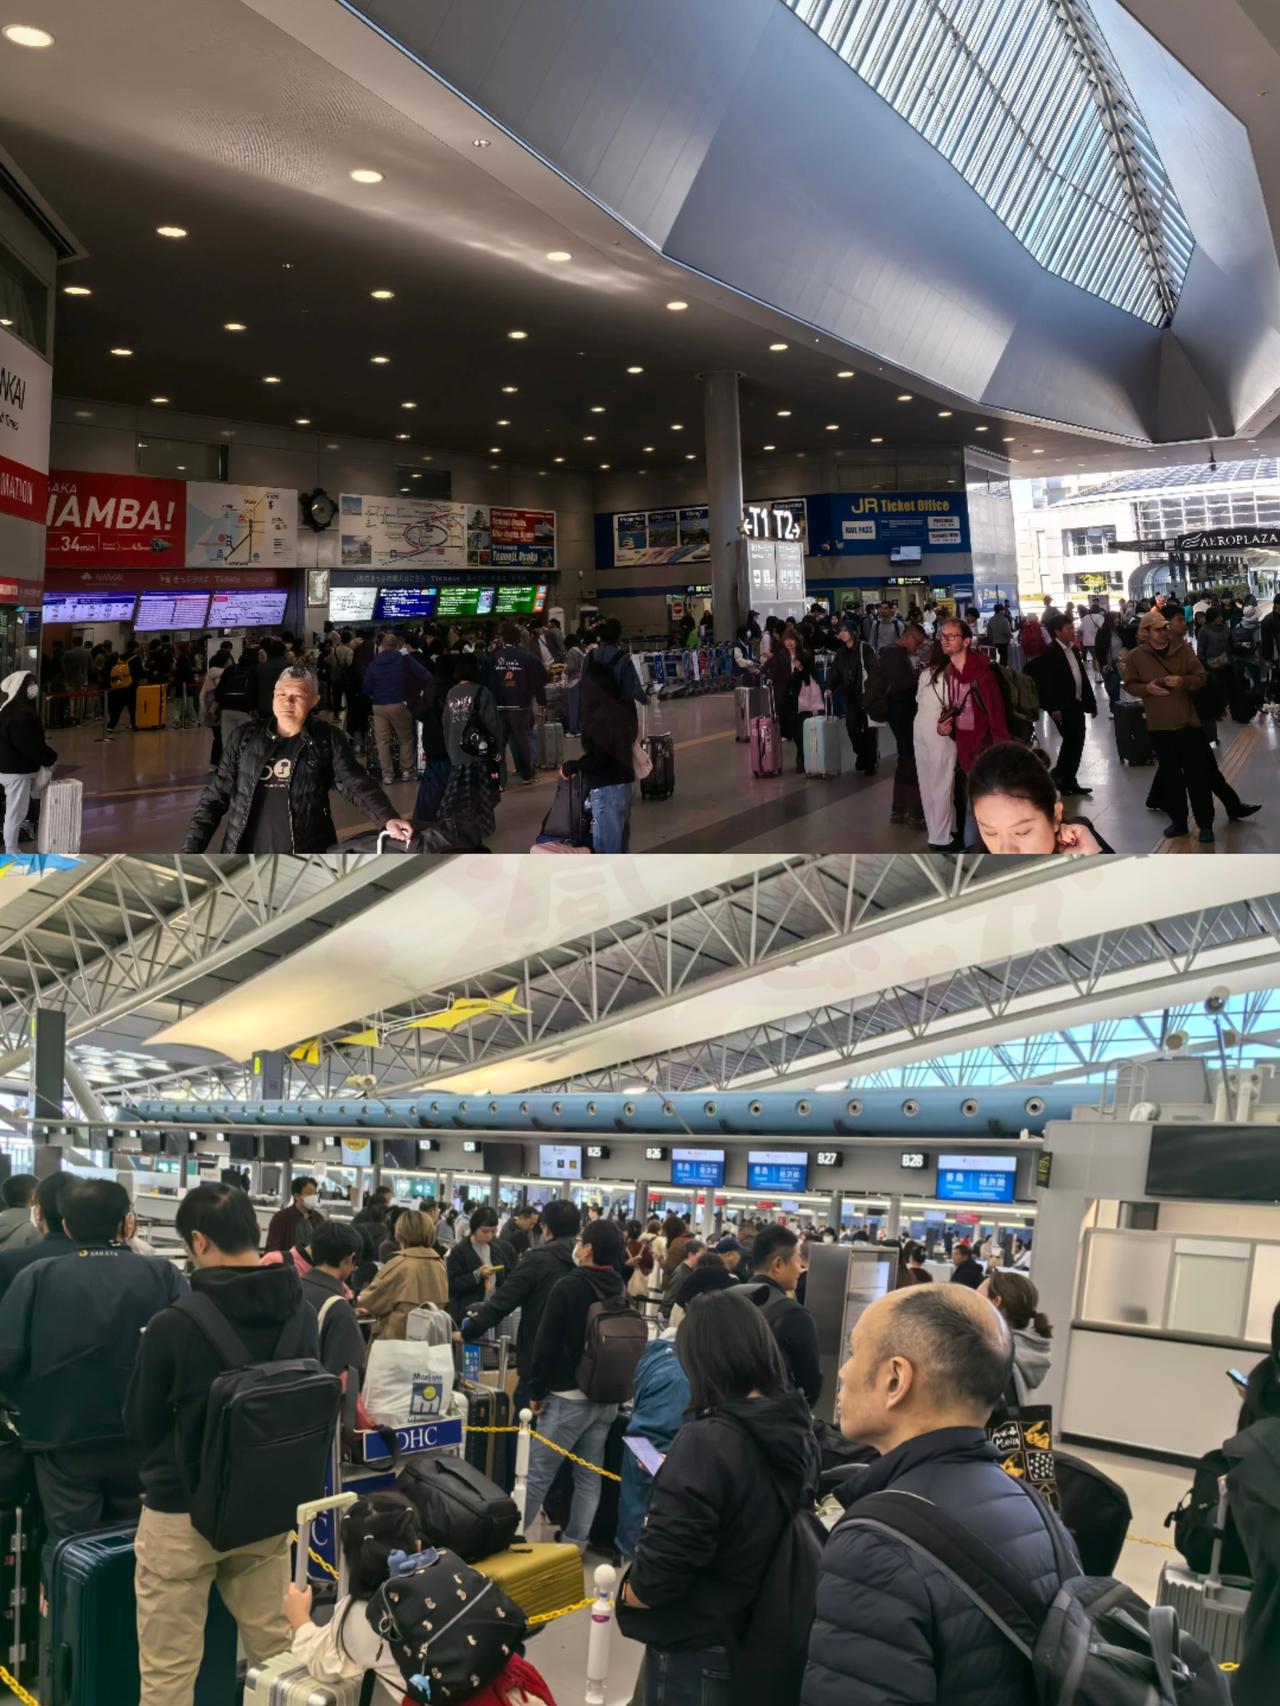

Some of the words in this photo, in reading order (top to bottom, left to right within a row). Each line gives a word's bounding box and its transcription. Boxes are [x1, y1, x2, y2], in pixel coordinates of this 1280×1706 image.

[0, 368, 26, 410] NKAI
[851, 497, 879, 514] JR
[880, 499, 915, 513] Ticket
[917, 498, 950, 512] Office
[749, 507, 769, 537] T1
[773, 510, 794, 539] T2
[1200, 533, 1279, 547] AEROPLAZA
[646, 1148, 661, 1159] B26
[817, 1152, 837, 1165] B27
[902, 1154, 923, 1167] B28
[396, 1426, 438, 1451] DHC
